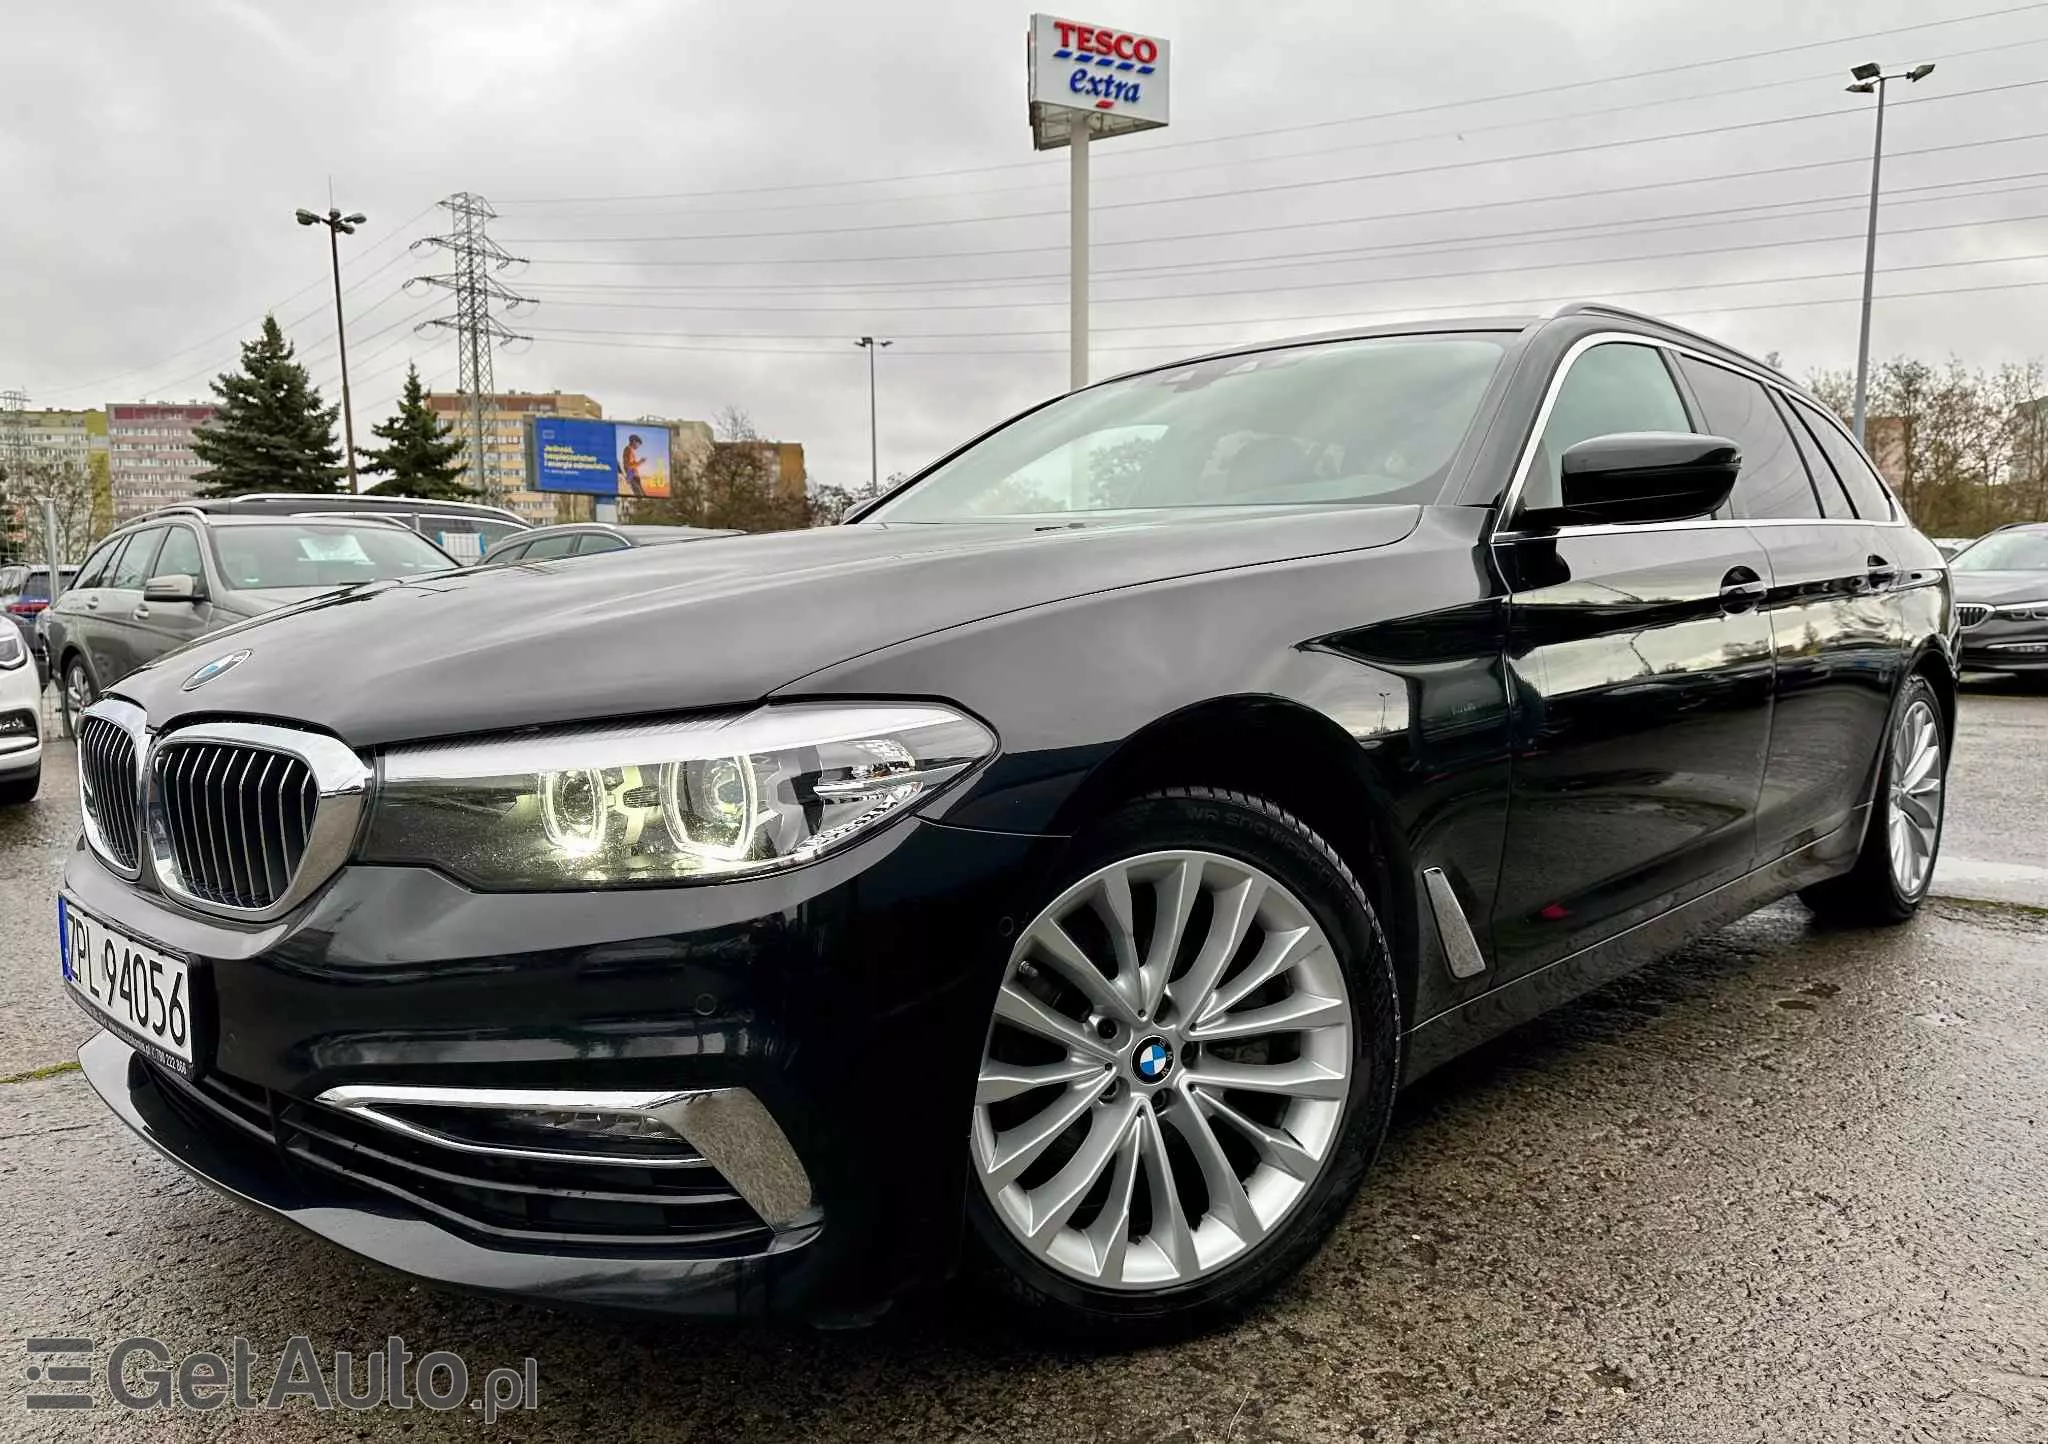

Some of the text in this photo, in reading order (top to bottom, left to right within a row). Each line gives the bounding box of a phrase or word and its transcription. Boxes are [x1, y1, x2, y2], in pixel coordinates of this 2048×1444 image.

[1053, 20, 1158, 64] TESCO
[1070, 68, 1141, 103] extra
[67, 912, 100, 999] ZPL
[104, 938, 186, 1047] 94056
